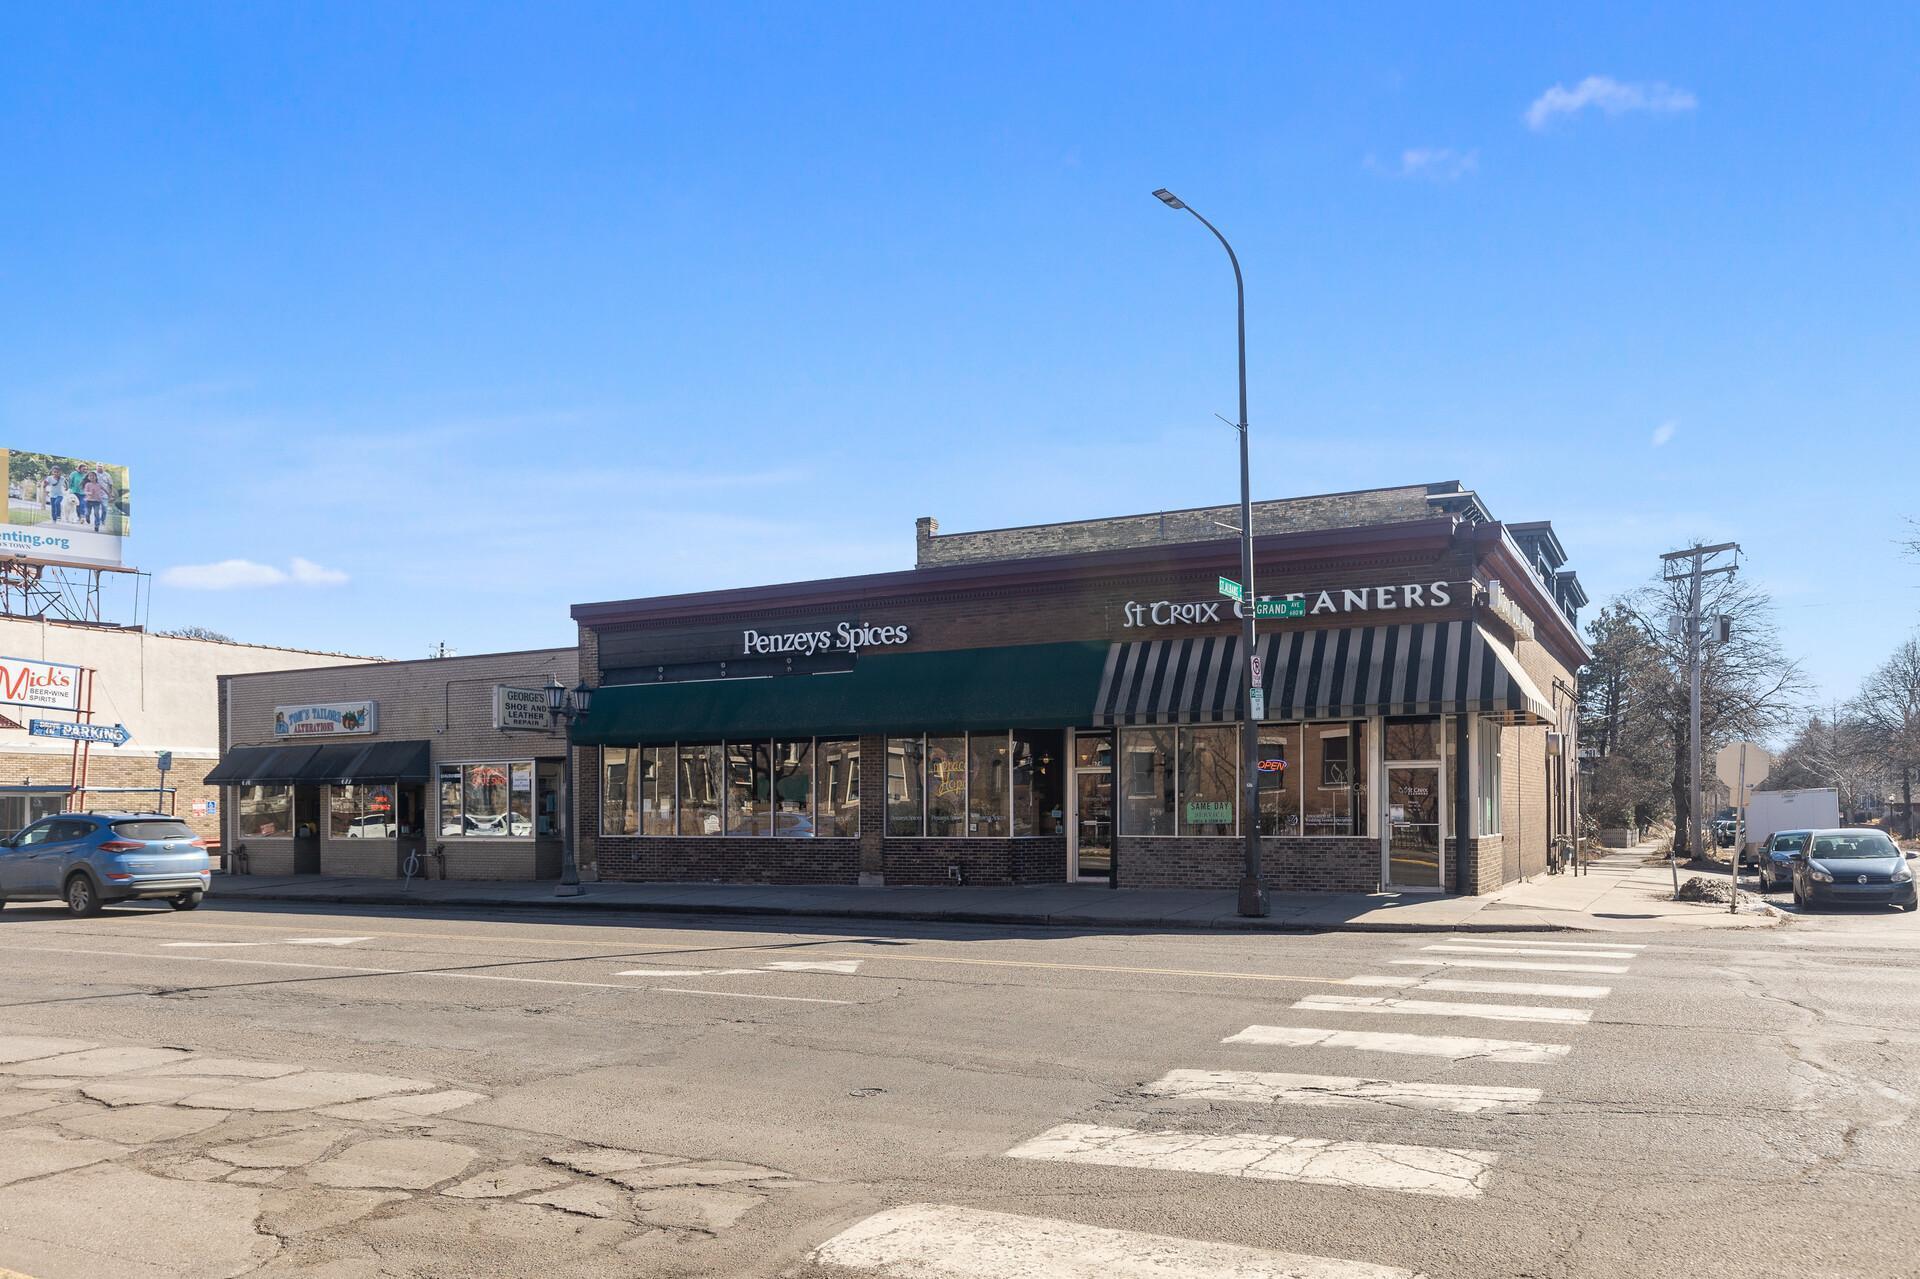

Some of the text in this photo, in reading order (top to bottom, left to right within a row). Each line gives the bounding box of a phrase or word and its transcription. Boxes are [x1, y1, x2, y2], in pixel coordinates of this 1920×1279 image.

[0, 530, 70, 549] nting.org
[1149, 600, 1220, 625] CROIX
[1256, 603, 1287, 615] GRAND
[743, 621, 909, 656] Penzeys Spices
[29, 695, 57, 703] SPIRITS
[505, 702, 547, 713] SHOE AND
[508, 711, 544, 720] LEATHER
[62, 724, 124, 740] PARKING
[1257, 760, 1285, 771] OPEN
[1191, 802, 1229, 810] SAME DAY
